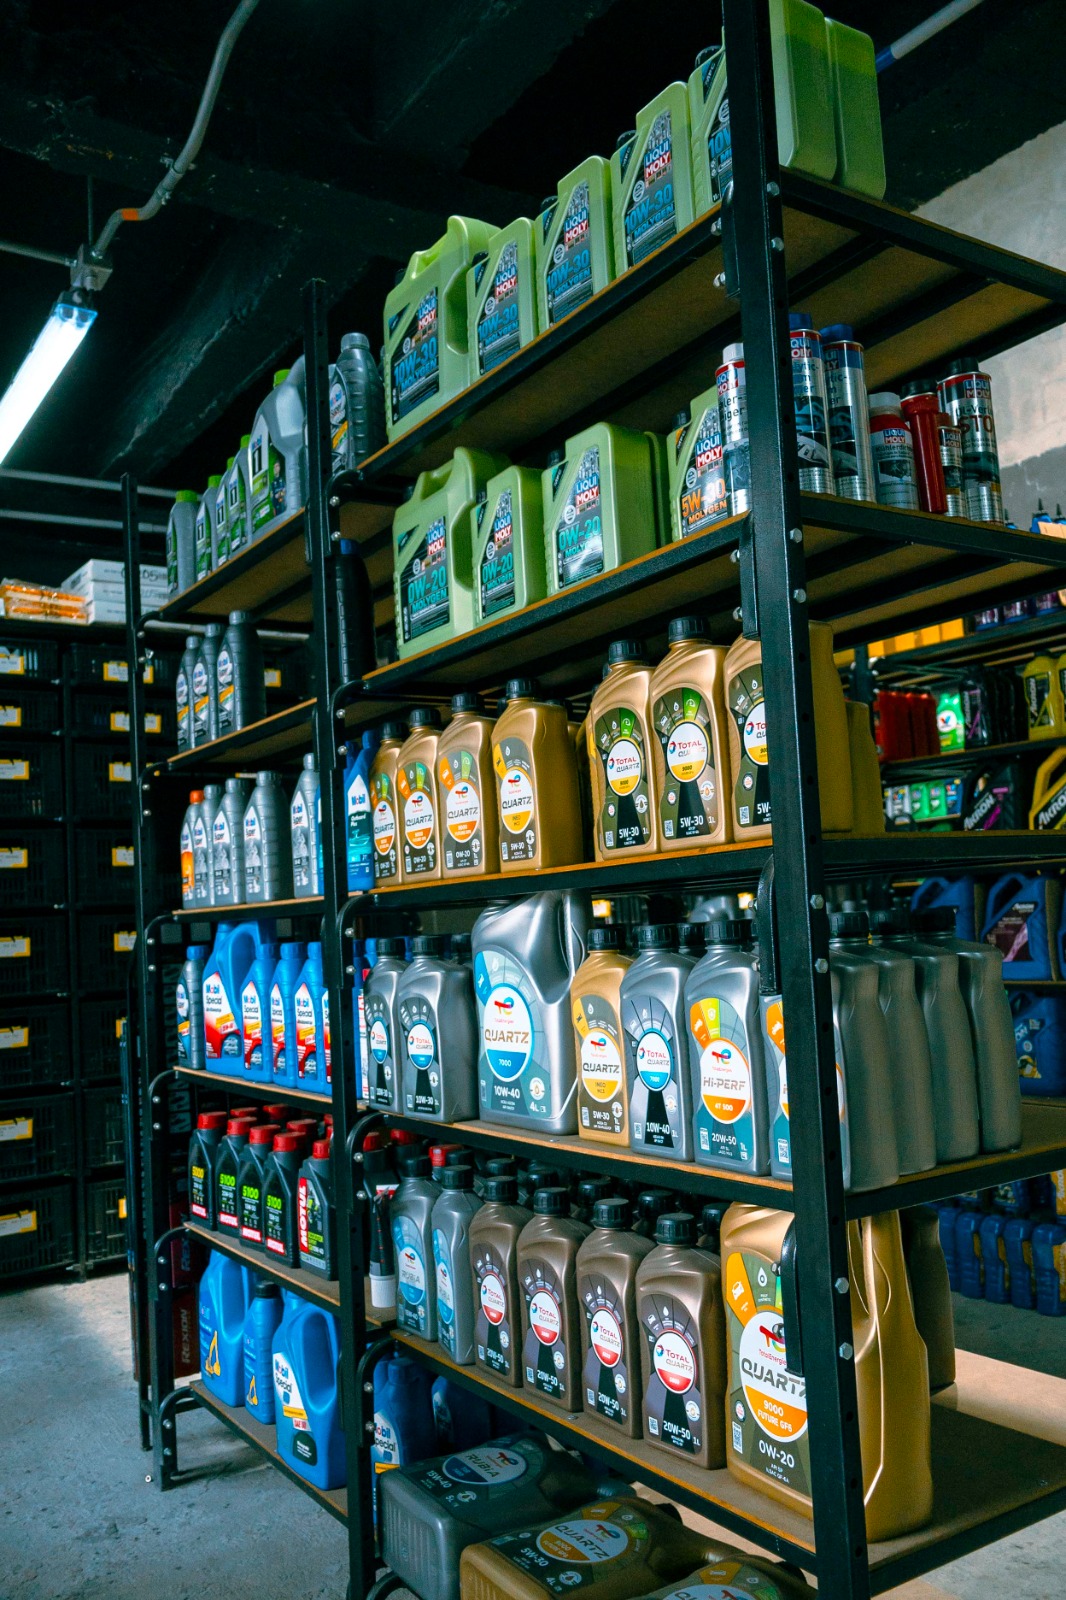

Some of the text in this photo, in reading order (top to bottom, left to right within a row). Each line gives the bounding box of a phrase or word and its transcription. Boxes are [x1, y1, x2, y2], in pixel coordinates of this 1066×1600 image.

[645, 140, 669, 167] LIQUI
[646, 153, 670, 178] MOLY
[625, 183, 673, 234] 10W-30
[565, 211, 587, 232] LIQUI
[634, 202, 674, 238] MOLYGEN
[565, 222, 588, 242] MOLY
[496, 265, 516, 285] LIQUI
[547, 249, 589, 290] 10W-30
[496, 277, 516, 296] MOLY
[555, 266, 591, 297] MOLYGEN
[418, 296, 436, 318] LIQUI
[418, 310, 437, 330] MOLY
[478, 304, 518, 338] 10W-30
[485, 322, 518, 347] MOLYGEN
[394, 337, 437, 386] 10W-30
[401, 361, 437, 392] MOLYGEN
[965, 390, 990, 398] MOLY
[884, 428, 905, 436] LIQUI
[696, 433, 721, 455] LIQUI
[697, 446, 722, 467] MOLY
[576, 476, 597, 492] LIQUI
[576, 487, 599, 506] MOLY
[688, 500, 727, 524] MOLYGEN
[495, 514, 511, 531] LIQUI
[427, 525, 444, 543] LIQUI
[495, 525, 512, 542] MOLY
[559, 516, 601, 550] 0W-20
[428, 538, 445, 555] MOLY
[482, 553, 513, 584] 0W-20
[408, 566, 446, 603] 0W-20
[487, 572, 514, 589] MOLYGEN
[412, 590, 447, 612] MOLYGEN
[617, 763, 640, 772] QUARTZ
[352, 796, 365, 806] Mobil
[502, 796, 532, 809] QUARTZ
[757, 802, 771, 814] 5W-
[406, 814, 432, 826] QUARTZ
[448, 807, 478, 819] QUARTZ
[680, 815, 703, 828] 5W-30
[375, 823, 394, 833] QUARTZ
[619, 827, 639, 838] 5W-30
[456, 850, 470, 858] 0W-20
[511, 842, 524, 850] 5W-30
[206, 984, 219, 994] Mobil
[206, 996, 222, 1004] Special
[297, 998, 309, 1007] Mobil
[485, 1029, 529, 1044] QUARTZ
[583, 1063, 620, 1073] QUARTZ
[415, 1096, 434, 1105] 10W-30
[494, 1085, 520, 1099] 10W-40
[530, 1102, 539, 1112] 4L
[593, 1111, 610, 1120] 5W-30
[646, 1122, 670, 1134] 10W-40
[712, 1133, 737, 1145] 20W-50
[220, 1174, 236, 1187] 5100
[242, 1186, 259, 1199] 5100
[267, 1195, 281, 1210] 5100
[299, 1186, 308, 1248] MOTUL
[539, 1316, 558, 1326] QUARTZ
[600, 1335, 620, 1348] QUARTZ
[759, 1349, 786, 1365] TotalEnergie
[275, 1359, 288, 1379] Mobil
[666, 1359, 693, 1374] QUARTZ
[276, 1373, 292, 1393] Special
[537, 1370, 558, 1386] 20W-50
[741, 1358, 806, 1399] QUARTZ
[598, 1392, 619, 1411] 20W-50
[764, 1400, 784, 1417] 9000
[758, 1409, 778, 1427] FUTURE
[664, 1421, 691, 1440] 20W-50
[694, 1436, 700, 1446] 1L
[759, 1440, 794, 1468] 0W-20
[426, 1469, 453, 1489] 15W-40
[555, 1525, 610, 1558] QUARTZ
[521, 1548, 549, 1566] 5W-30
[546, 1577, 556, 1586] 4L
